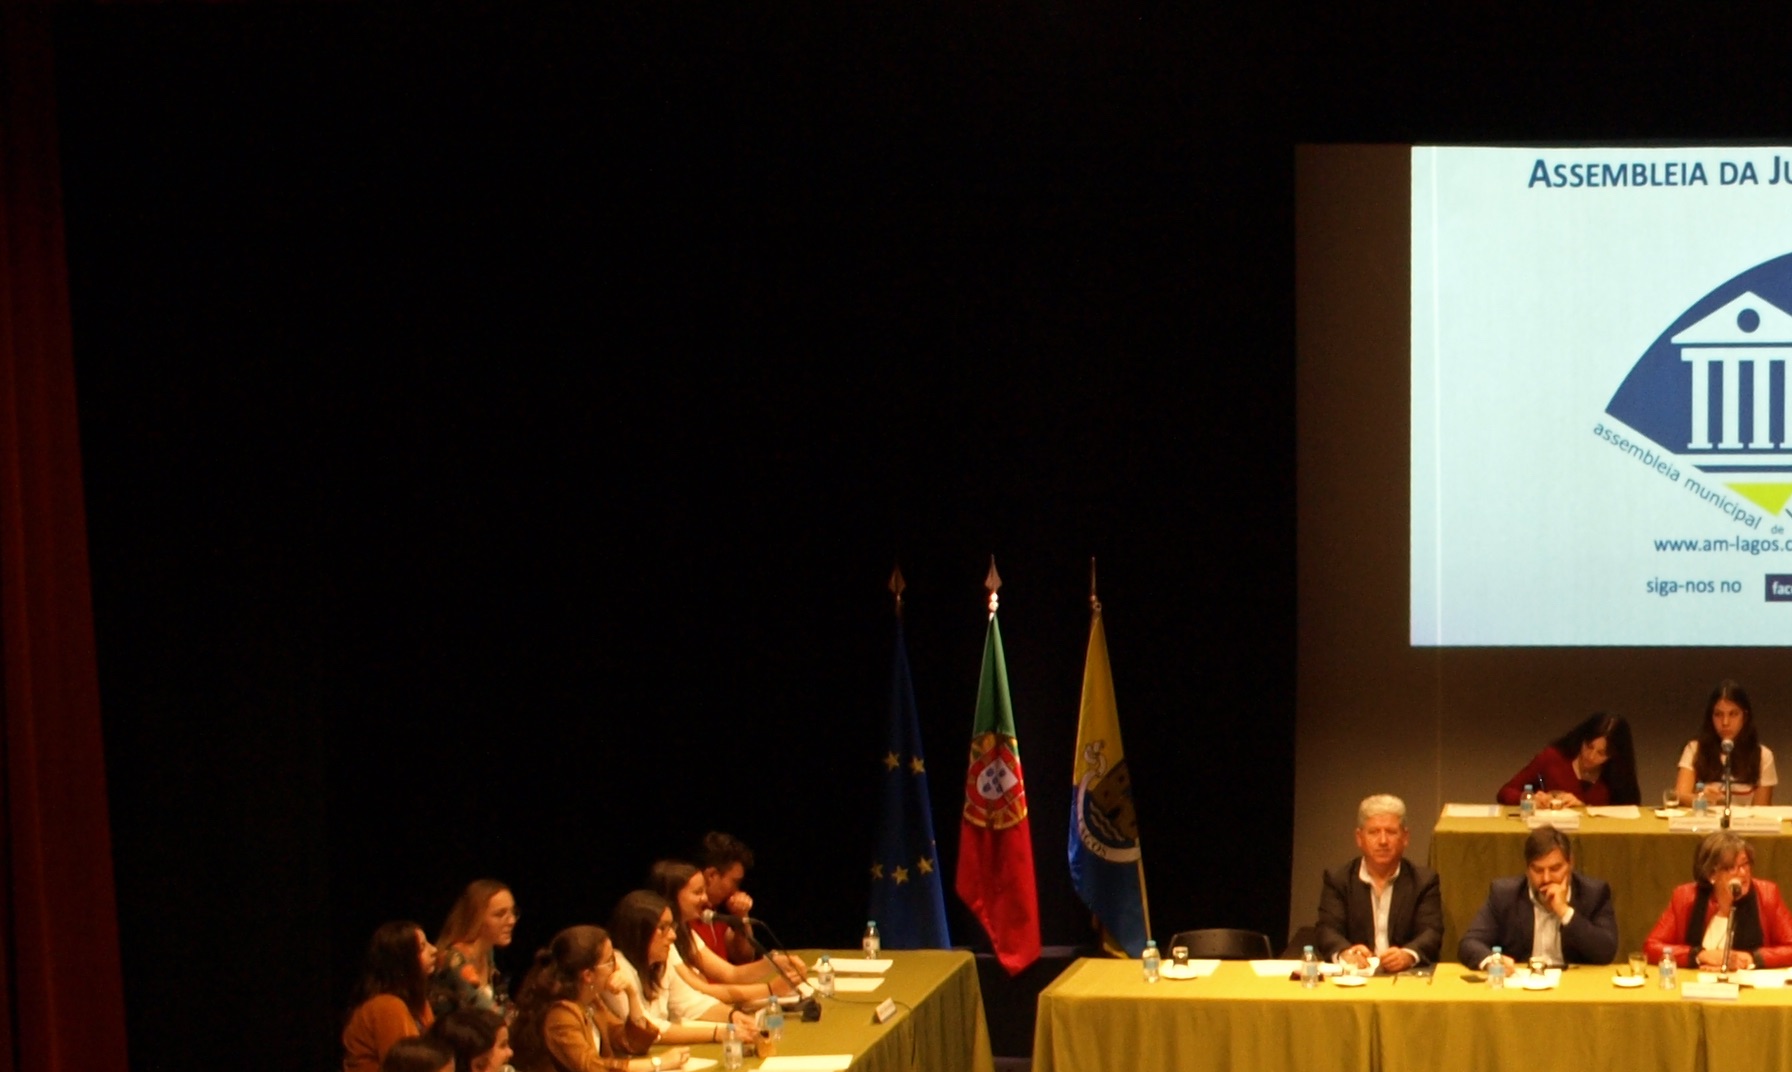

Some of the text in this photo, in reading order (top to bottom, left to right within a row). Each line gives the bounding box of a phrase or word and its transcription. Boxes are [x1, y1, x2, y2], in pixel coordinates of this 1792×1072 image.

[1528, 159, 1708, 188] ASSEMBLEIA
[1719, 161, 1759, 186] DA
[1592, 421, 1763, 531] assembleia municipal
[1770, 524, 1785, 536] de
[1646, 577, 1743, 597] siga-nos no
